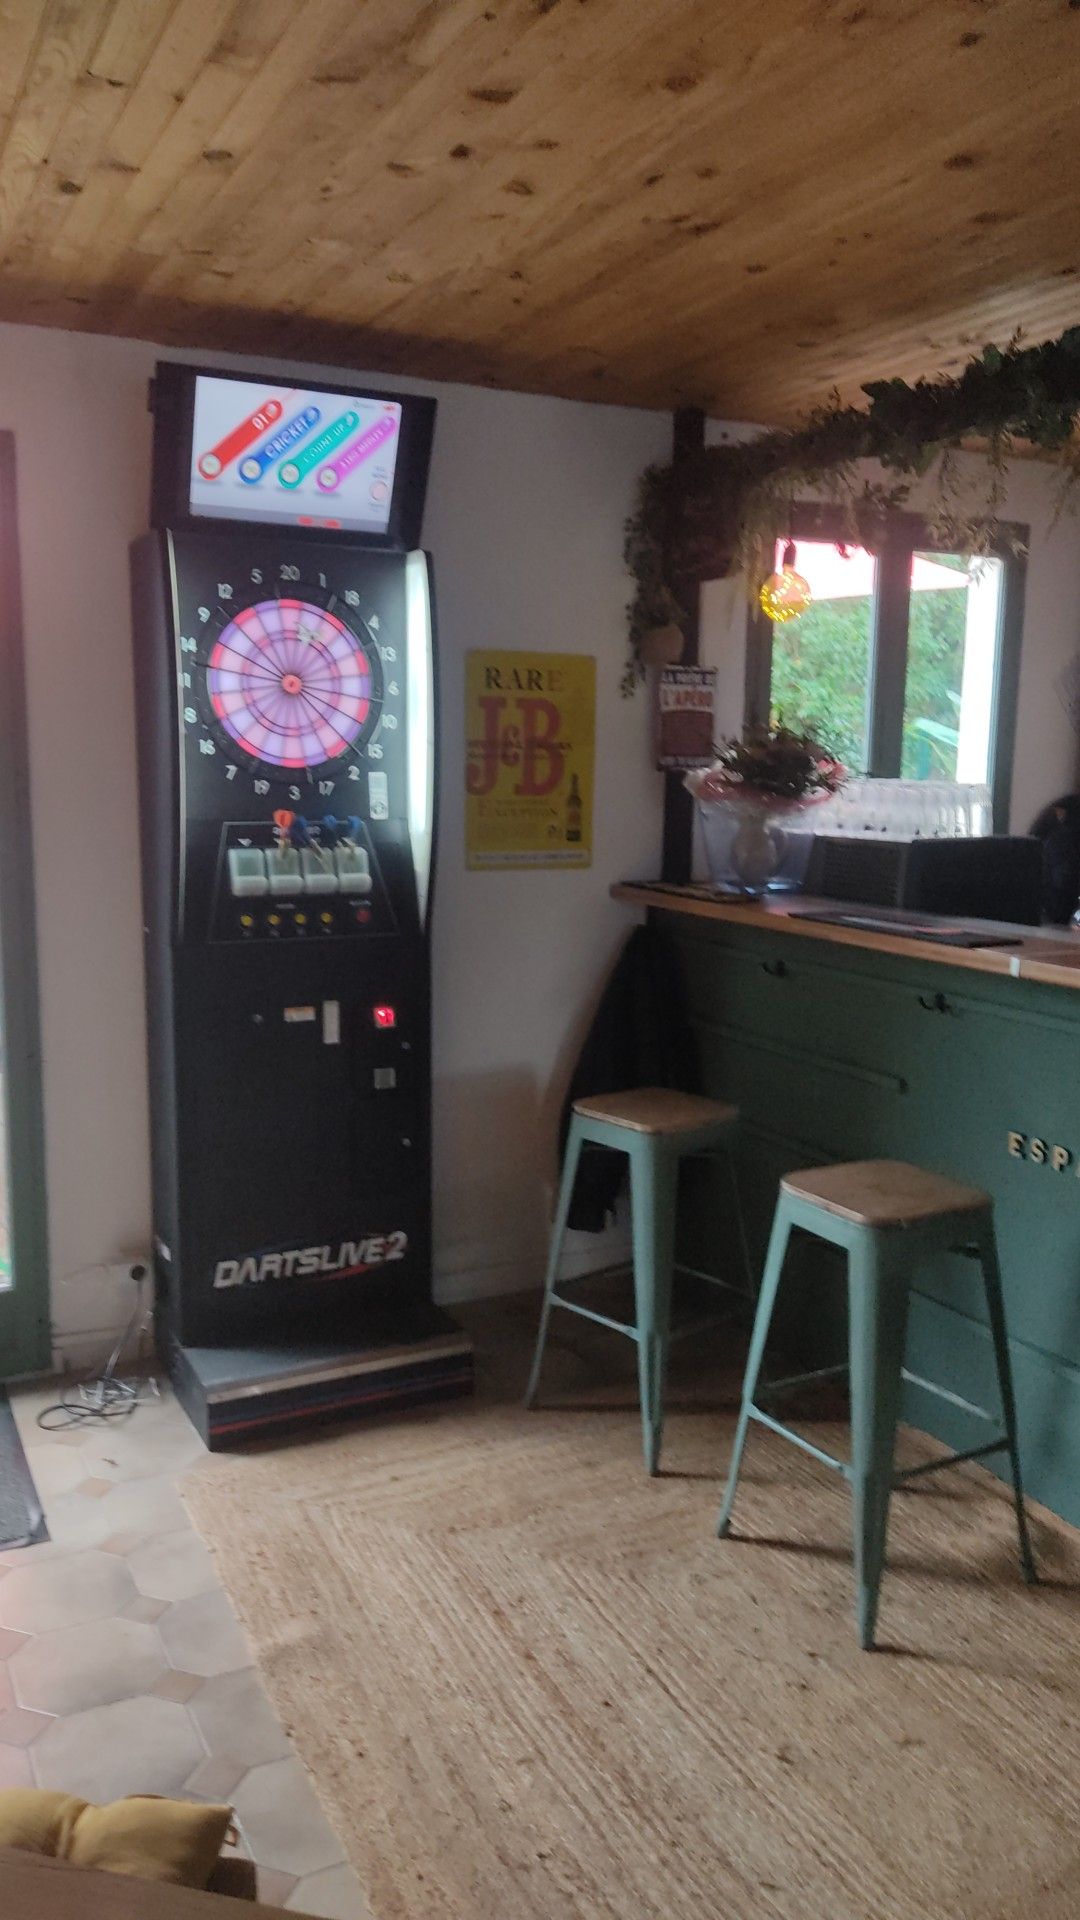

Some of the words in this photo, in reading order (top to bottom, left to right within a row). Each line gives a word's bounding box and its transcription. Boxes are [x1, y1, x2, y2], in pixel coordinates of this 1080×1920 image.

[264, 413, 307, 459] CRICKET
[251, 569, 262, 584] 5
[280, 564, 300, 580] 20
[319, 572, 326, 588] 1
[198, 606, 210, 623] 9
[368, 614, 379, 631] 4
[484, 666, 562, 691] RARE
[388, 681, 399, 696] 6
[184, 707, 197, 724] 8
[381, 714, 398, 730] 10
[465, 696, 566, 797] J&B
[225, 765, 238, 780] 7
[348, 765, 360, 781] 2
[254, 779, 270, 795] 19
[288, 785, 300, 800] 3
[318, 781, 335, 796] 17
[1007, 1131, 1080, 1178] ESP
